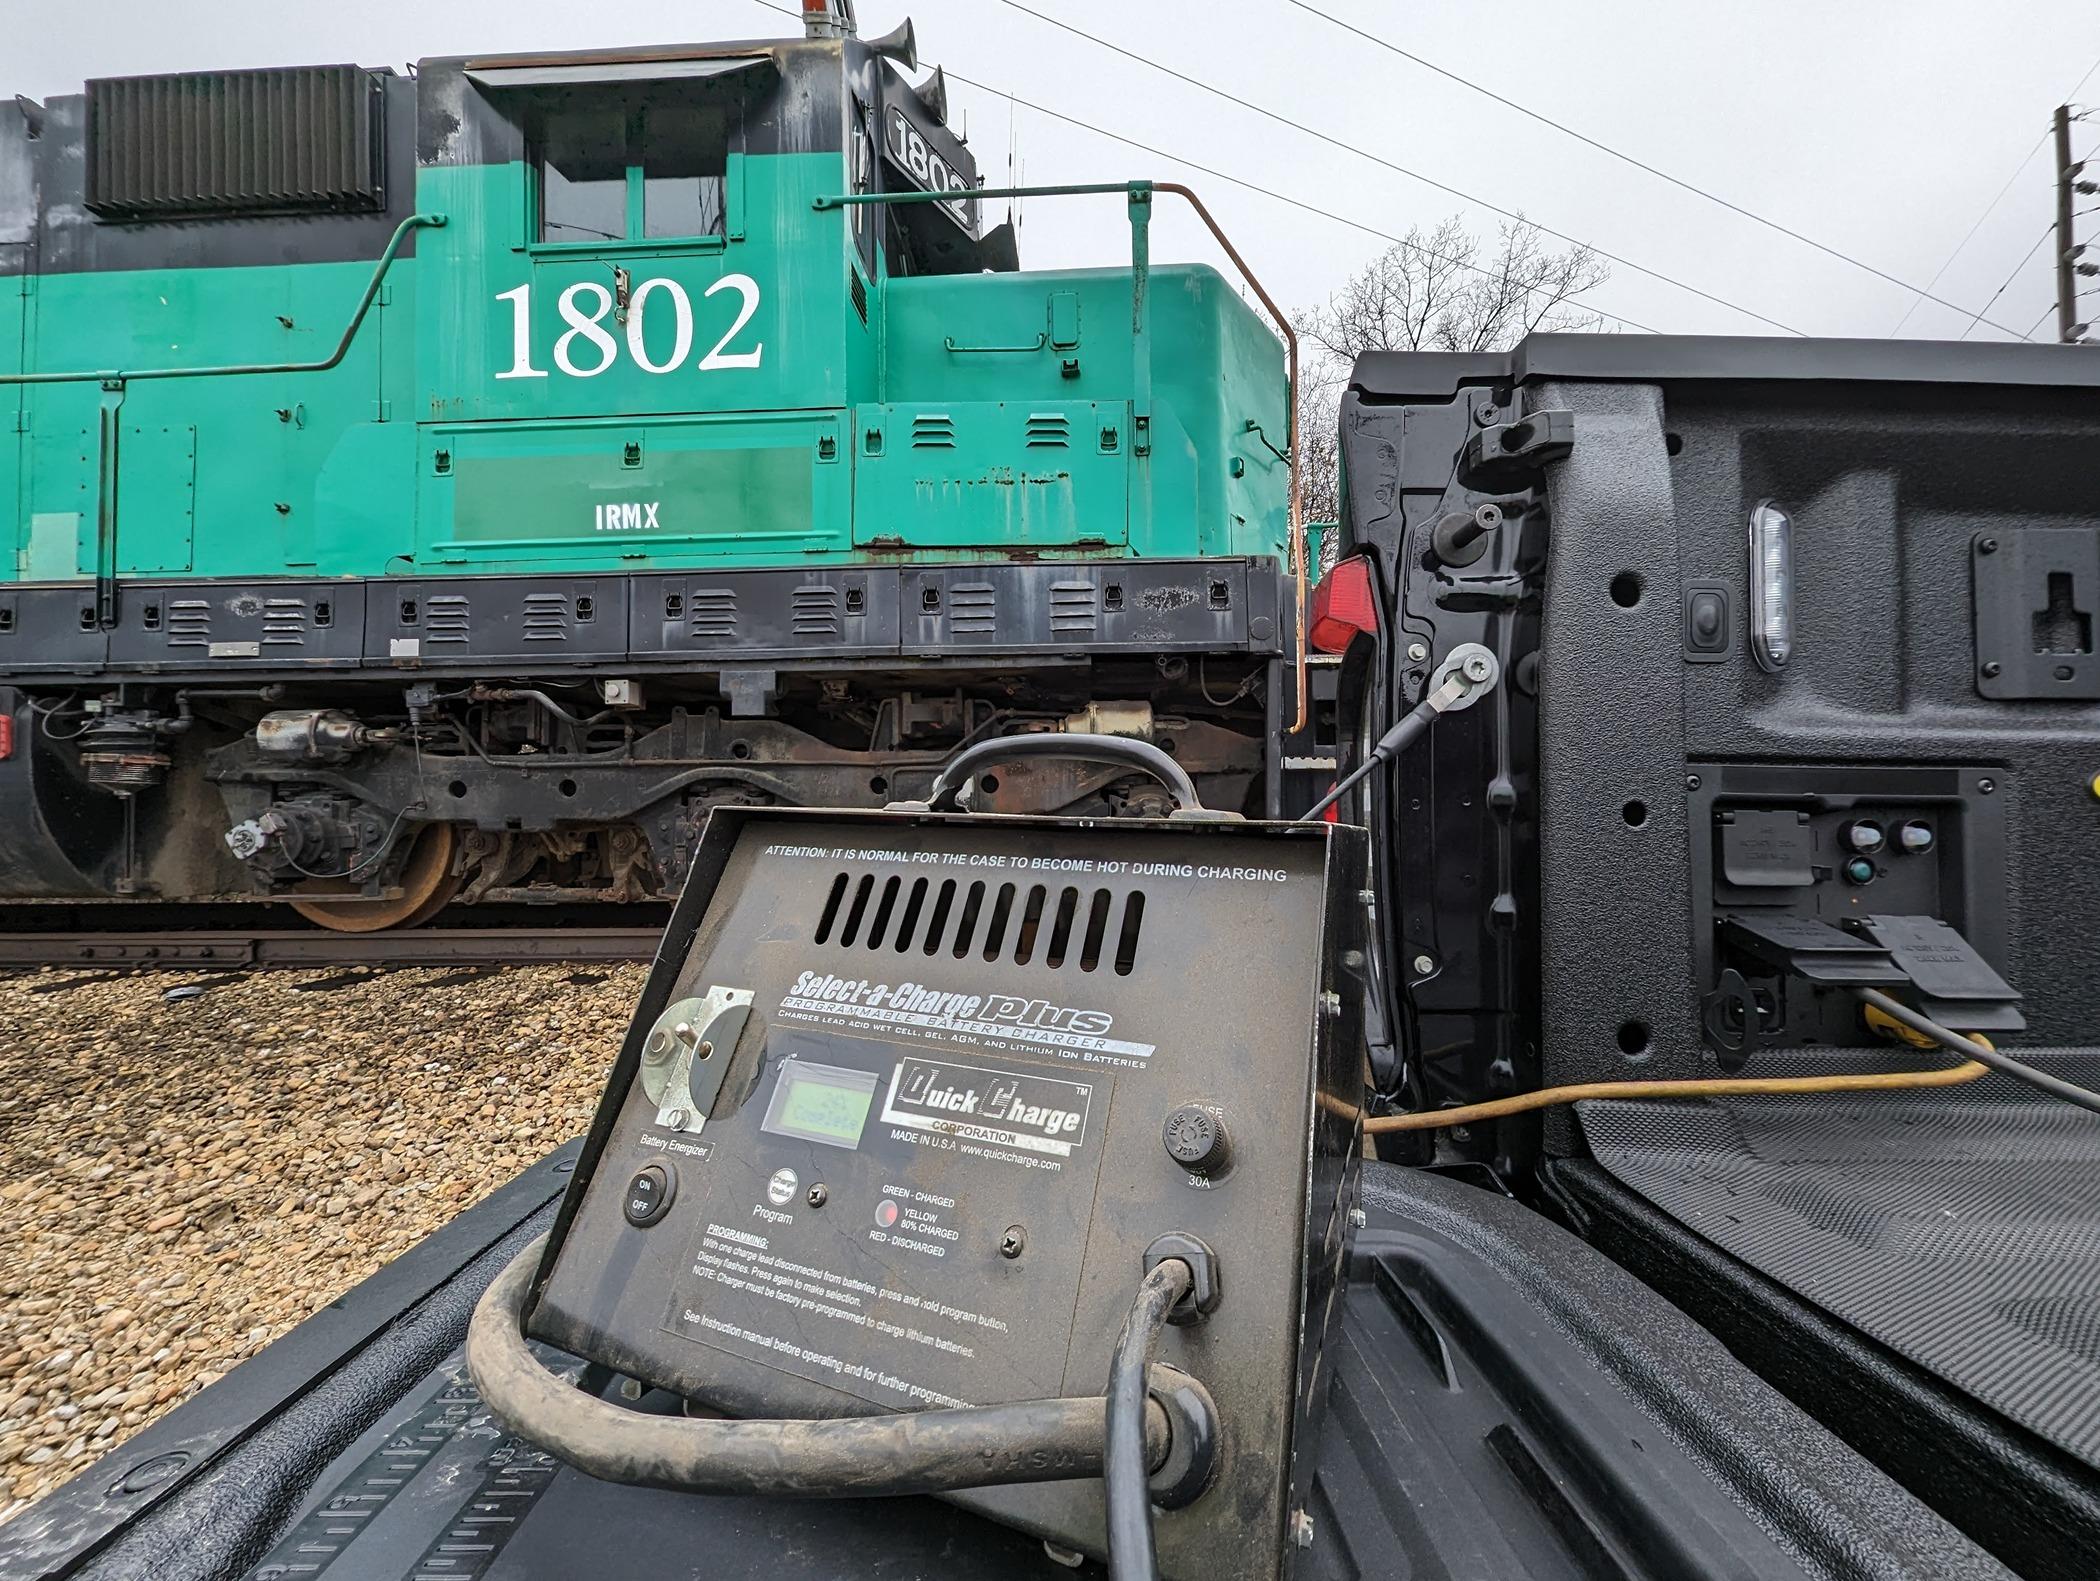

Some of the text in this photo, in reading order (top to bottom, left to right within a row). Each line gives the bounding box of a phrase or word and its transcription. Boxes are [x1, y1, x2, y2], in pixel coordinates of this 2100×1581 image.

[895, 118, 968, 225] 1802
[495, 273, 763, 379] 1802
[595, 501, 660, 530] IRMX
[765, 845, 1287, 882] ATTENTION: IT IS NORMAL FOR THE CASE TO BECOME HOT DURING CHARGING
[790, 970, 982, 1019] Select-a-Charge
[783, 997, 1107, 1049] PROGRAMMABLE BATTERY CHARGER
[897, 1066, 980, 1114] Quick
[1075, 1087, 1088, 1096] TM
[931, 1120, 1017, 1145] CORPORATION
[1169, 1114, 1186, 1136] FUSE
[1194, 1115, 1210, 1139] FUSE
[640, 1133, 709, 1157] Battery Energizer
[890, 1128, 918, 1144] MADE
[919, 1134, 931, 1146] IN
[960, 1143, 1062, 1172] www.quickcharge.com
[639, 1178, 651, 1191] ON
[770, 1186, 791, 1198] Status
[773, 1175, 796, 1188] Charge
[1188, 1174, 1211, 1189] 30A
[632, 1199, 649, 1212] OFF
[882, 1184, 911, 1199] GREEN
[915, 1191, 955, 1208] CHARGED
[753, 1204, 794, 1225] Program
[904, 1207, 938, 1223] YELLOW
[706, 1223, 770, 1249] PROGRAMMING:
[900, 1219, 959, 1241] 80% CHARGED
[869, 1230, 887, 1242] RED
[891, 1235, 946, 1257] DISCHARGED
[697, 1250, 861, 1308] Display flashes. Press again to make selection.
[702, 1237, 719, 1250] With
[718, 1242, 733, 1254] one
[732, 1246, 758, 1262] charge
[758, 1252, 775, 1266] lead
[774, 1257, 823, 1279] disconnected
[823, 1270, 842, 1285] from
[842, 1276, 877, 1296] batteries,
[878, 1288, 903, 1302] press
[903, 1294, 920, 1307] and
[940, 1304, 977, 1325] program
[978, 1313, 1009, 1333] button,
[692, 1265, 975, 1359] NOTE: Charger must be factory pre-programmed to charge lithium batteries.
[684, 1309, 701, 1324] See
[701, 1315, 741, 1337] Instruction
[742, 1329, 774, 1348] manual
[774, 1337, 801, 1357] before
[802, 1349, 844, 1374] operating
[844, 1363, 863, 1377] and
[863, 1367, 880, 1382] for
[878, 1371, 910, 1393] further
